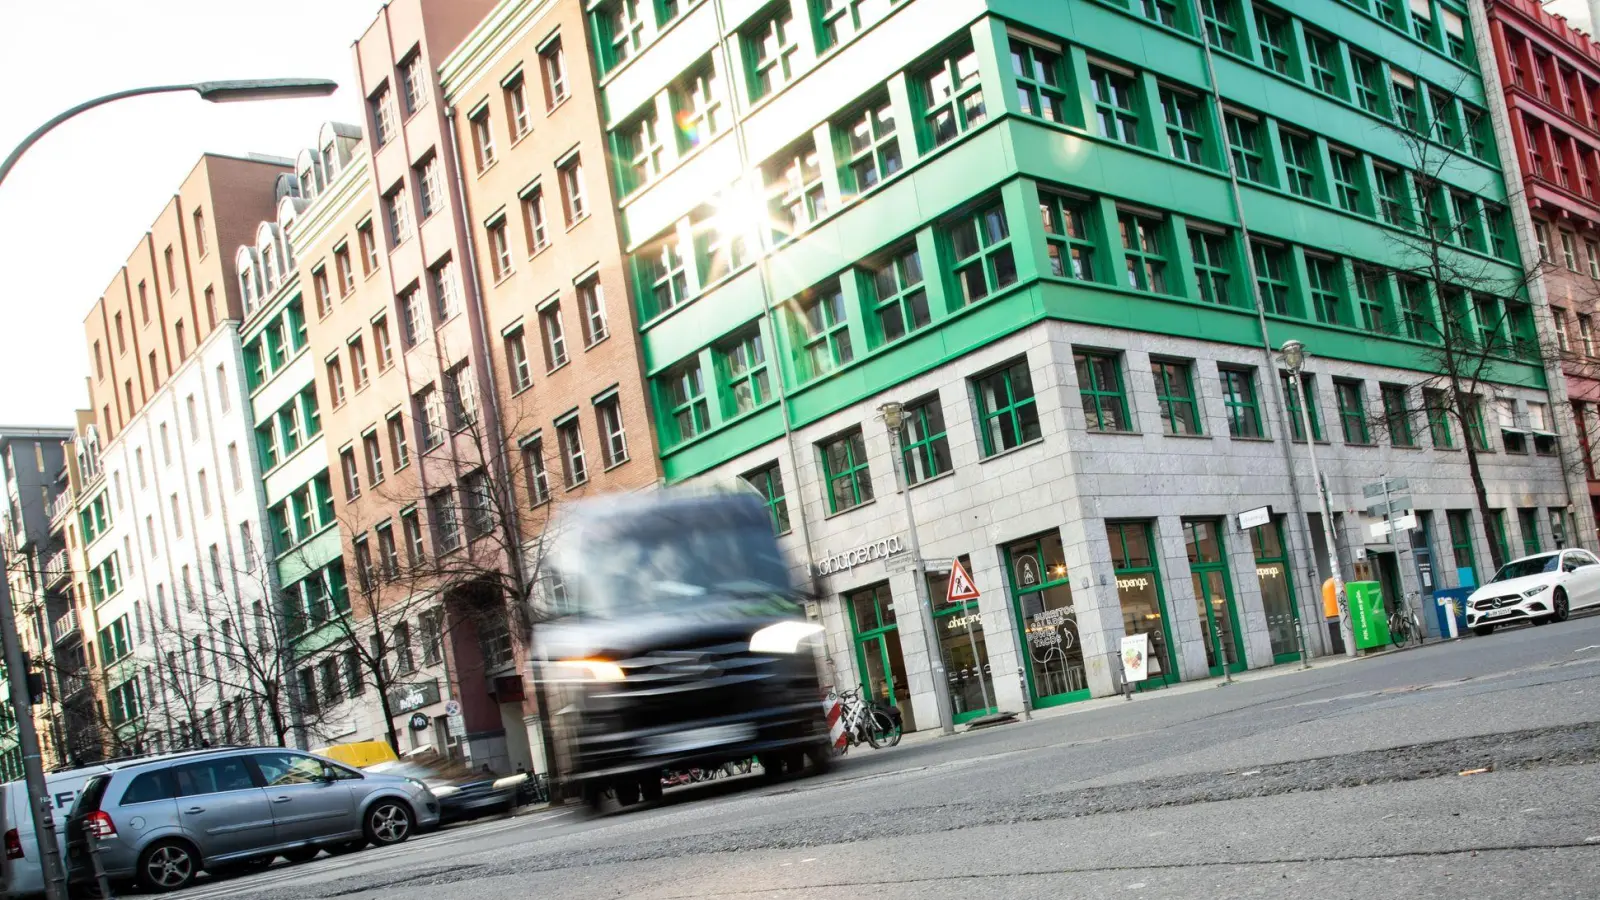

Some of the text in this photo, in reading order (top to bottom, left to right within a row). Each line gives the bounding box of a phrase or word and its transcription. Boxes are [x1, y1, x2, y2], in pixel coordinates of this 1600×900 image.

[817, 535, 904, 577] chupenga
[1256, 566, 1280, 579] upenga
[1114, 576, 1149, 592] hupenga
[947, 612, 983, 629] chupeng
[1033, 634, 1063, 648] TACOS
